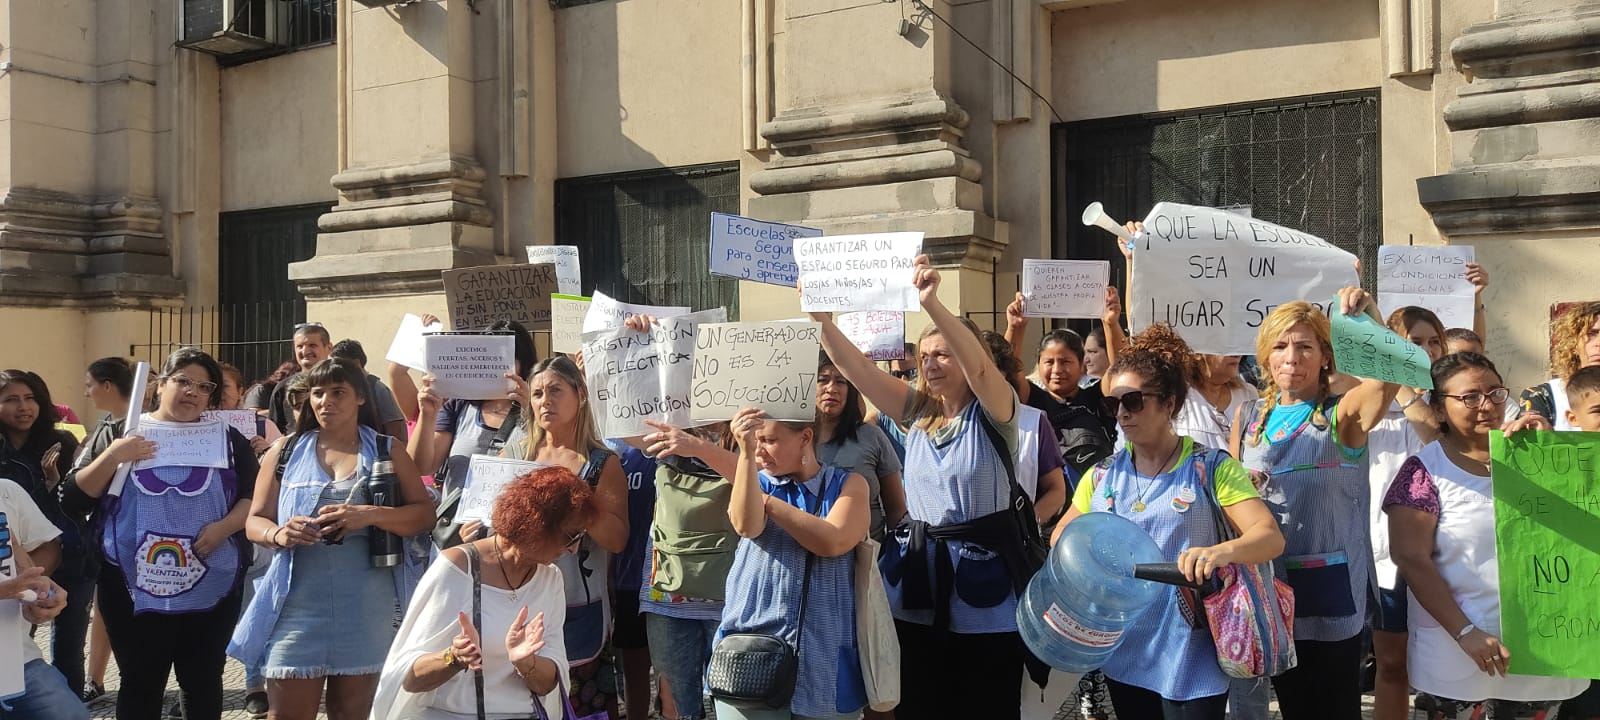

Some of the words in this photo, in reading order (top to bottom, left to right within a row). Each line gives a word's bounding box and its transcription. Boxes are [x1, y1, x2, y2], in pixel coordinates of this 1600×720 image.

[727, 218, 785, 241] Escuelas
[1212, 217, 1239, 241] LA
[727, 249, 752, 262] para
[755, 240, 793, 259] Segur
[800, 239, 868, 256] GARANTIZAR
[875, 239, 892, 251] UN
[741, 267, 750, 279] y
[801, 259, 842, 273] ESPACIO
[845, 259, 888, 271] SEGURO
[890, 255, 915, 270] PARA
[1189, 255, 1228, 279] SEA
[1250, 256, 1275, 277] UN
[457, 265, 554, 291] GARANTIZAR
[880, 277, 888, 292] Y
[455, 291, 473, 303] LA
[467, 302, 487, 316] SIN
[493, 301, 527, 313] PONER
[1152, 297, 1225, 328] LUGAR
[455, 318, 470, 330] EN
[518, 311, 529, 321] LA
[696, 327, 722, 350] UN
[724, 325, 821, 350] GENERADOR
[692, 355, 719, 379] NO
[729, 354, 755, 369] ES
[766, 349, 792, 368] LA
[597, 384, 617, 401] EN
[1511, 445, 1594, 477] QUE
[627, 471, 643, 490] 10
[1518, 493, 1550, 517] SE
[146, 567, 188, 578] VALENTINA
[1532, 554, 1570, 585] NO
